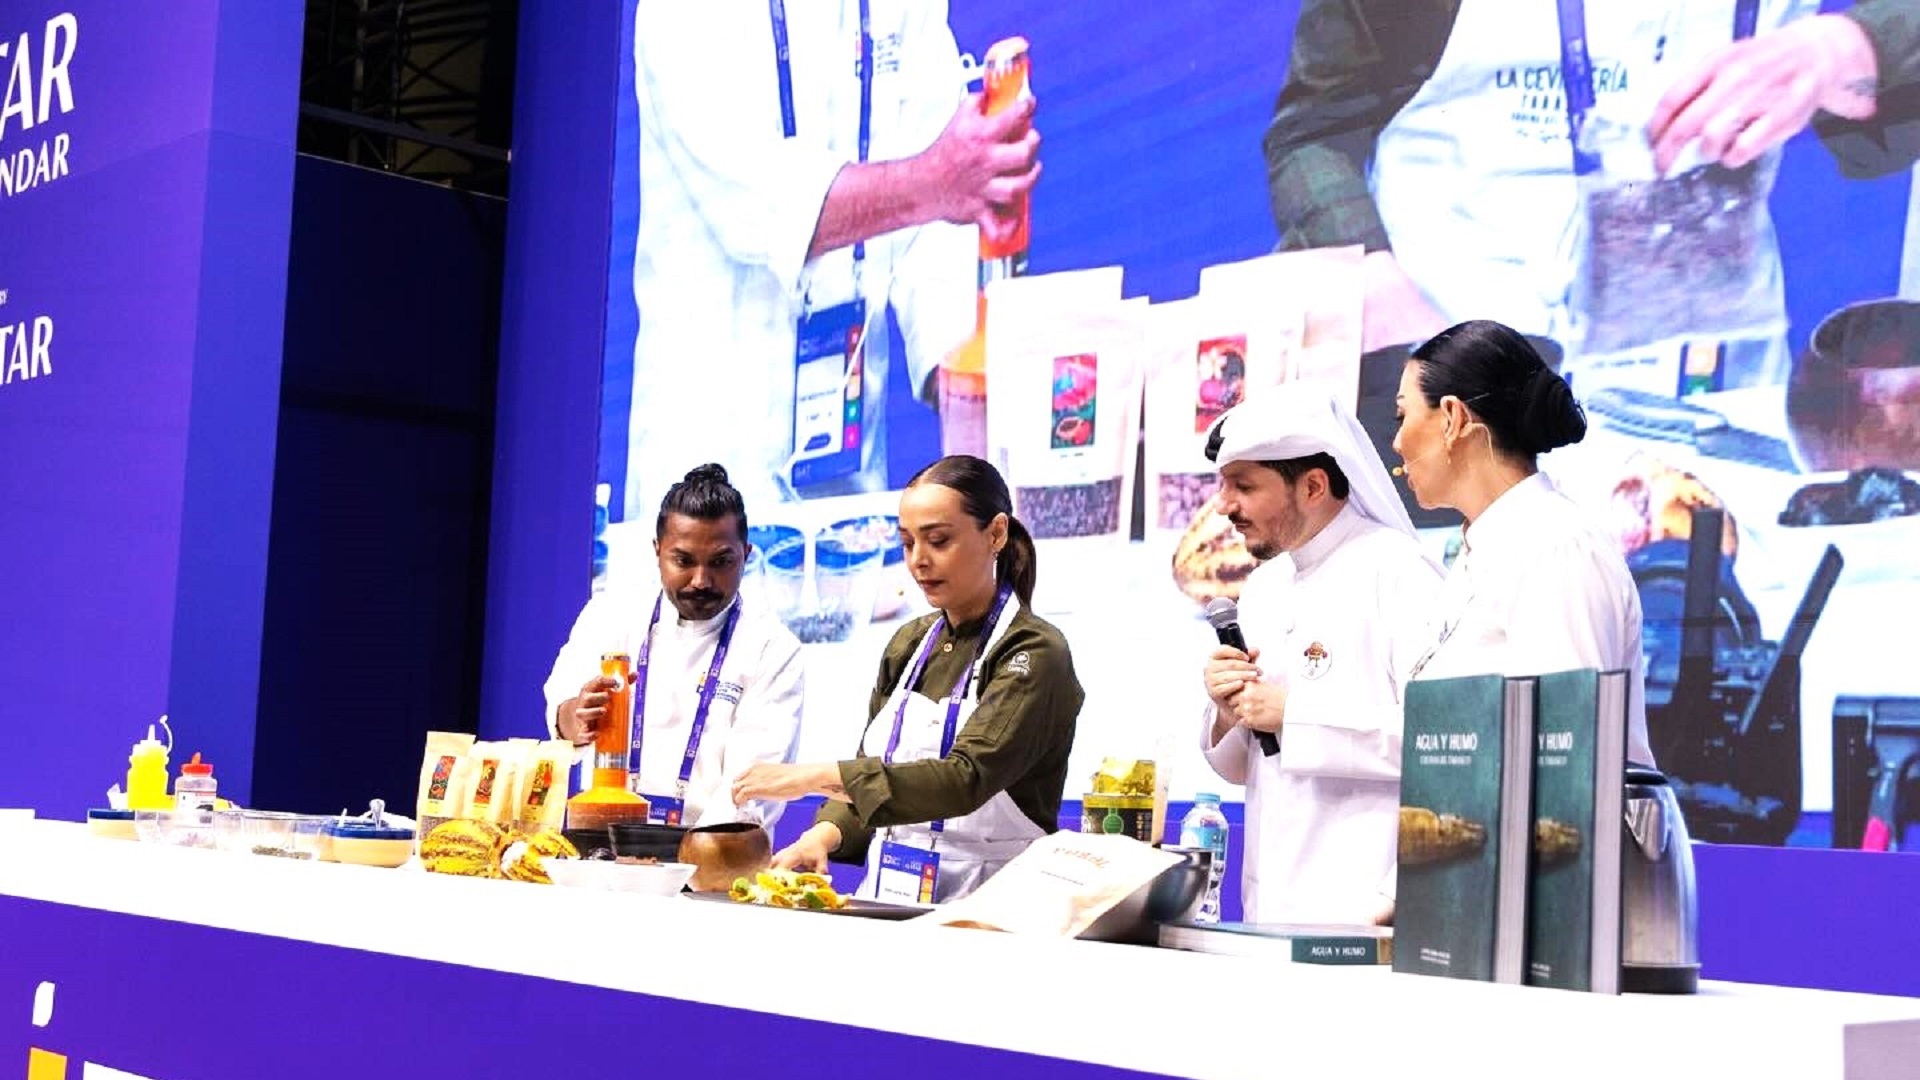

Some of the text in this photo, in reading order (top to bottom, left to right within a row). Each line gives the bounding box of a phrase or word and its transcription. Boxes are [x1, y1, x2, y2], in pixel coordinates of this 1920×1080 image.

[0, 12, 77, 141] AR
[1496, 67, 1518, 89] LA
[1415, 732, 1478, 750] AGUA Y HUMO
[1538, 731, 1573, 750] Y HUMO
[1311, 946, 1366, 957] AGUA Y HUMO
